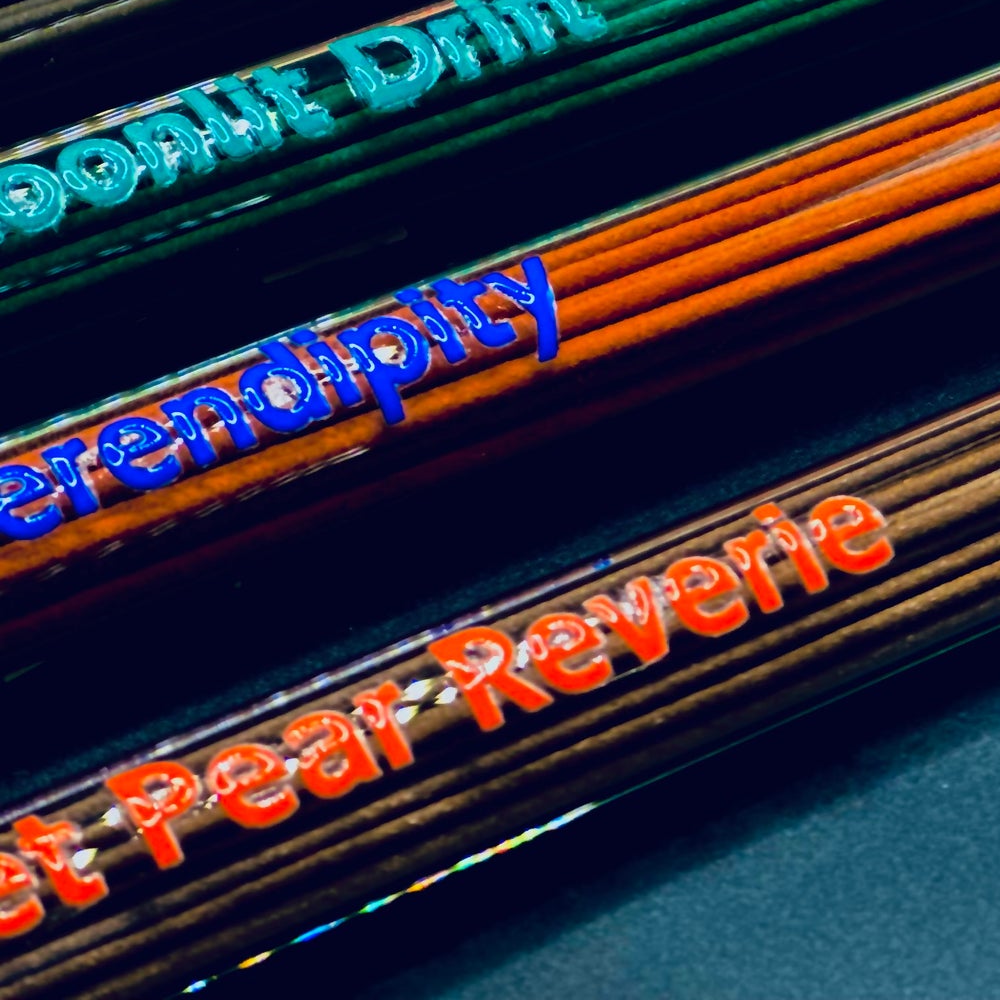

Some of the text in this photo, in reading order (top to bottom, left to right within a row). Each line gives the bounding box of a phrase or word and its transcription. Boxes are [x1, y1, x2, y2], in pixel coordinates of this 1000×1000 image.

[0, 64, 335, 244] oonlit
[106, 680, 414, 869] Pear
[428, 495, 895, 732] Reverie
